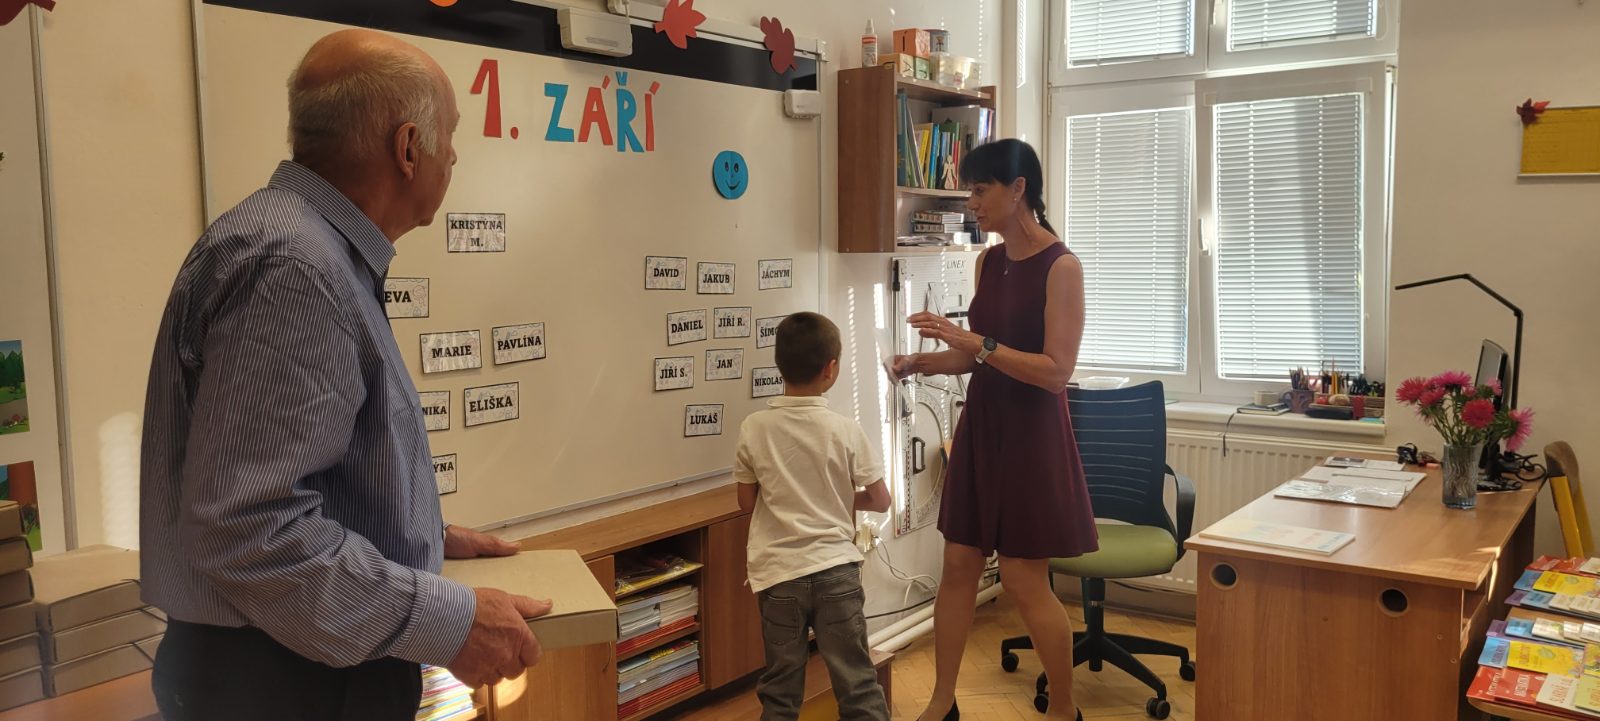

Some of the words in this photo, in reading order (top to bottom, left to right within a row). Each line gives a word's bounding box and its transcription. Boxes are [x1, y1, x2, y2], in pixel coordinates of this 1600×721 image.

[470, 59, 519, 140] 1.
[544, 71, 660, 153] ZÁŘÍ
[450, 218, 503, 230] KRISTÝNA
[470, 237, 484, 247] M.
[653, 268, 680, 278] DAVID
[702, 273, 730, 283] JAKUB
[761, 267, 790, 279] JÁCHYM
[384, 290, 412, 303] EVA
[671, 320, 704, 334] DANIEL
[718, 315, 735, 328] JIŘÍ
[737, 317, 746, 327] R.
[497, 334, 542, 351] PAVLÍNA
[431, 344, 473, 359] MARIE
[717, 359, 733, 369] JAN
[660, 365, 678, 379] JIŘÍ
[680, 367, 688, 378] S.
[754, 376, 783, 386] NIKOLAS
[468, 395, 514, 413] ELIŠKA
[690, 412, 718, 424] LUKÁŠ
